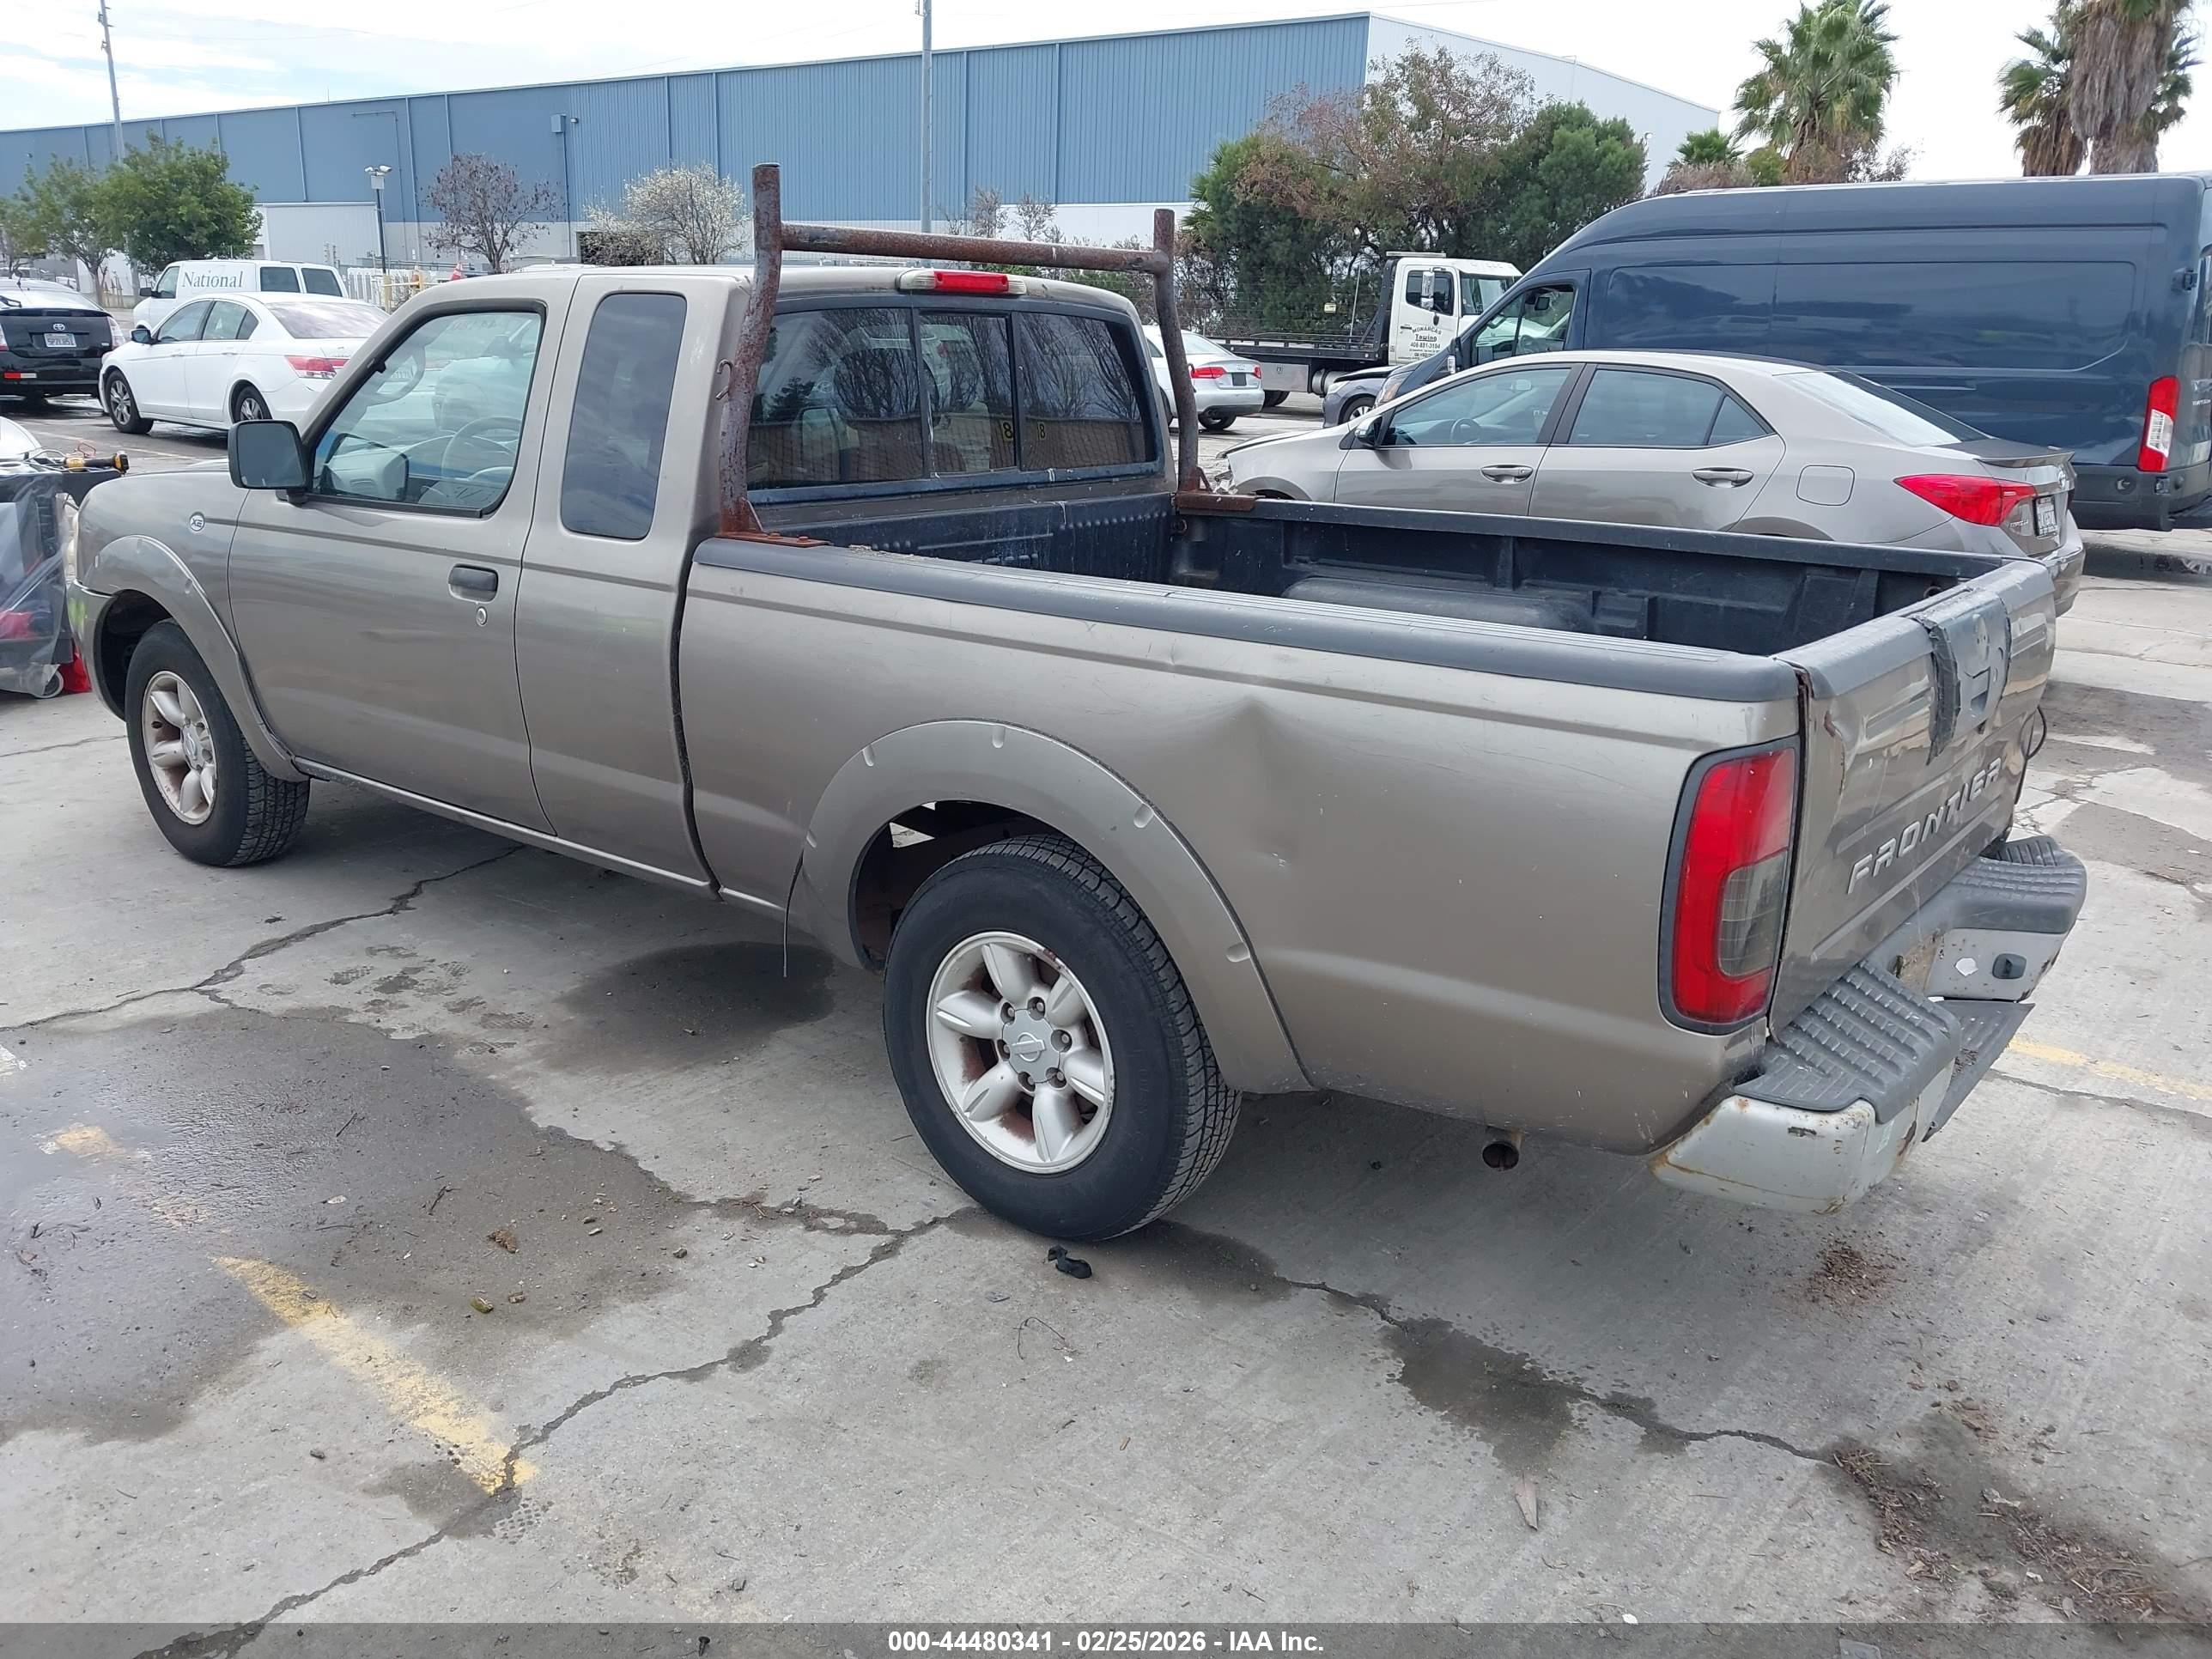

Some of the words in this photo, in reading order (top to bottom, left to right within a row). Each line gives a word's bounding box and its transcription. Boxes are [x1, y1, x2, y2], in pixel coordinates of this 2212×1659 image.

[181, 270, 243, 288] National
[1415, 333, 1437, 342] Towing
[191, 519, 203, 528] XE
[1846, 757, 2002, 895] FRONTIER
